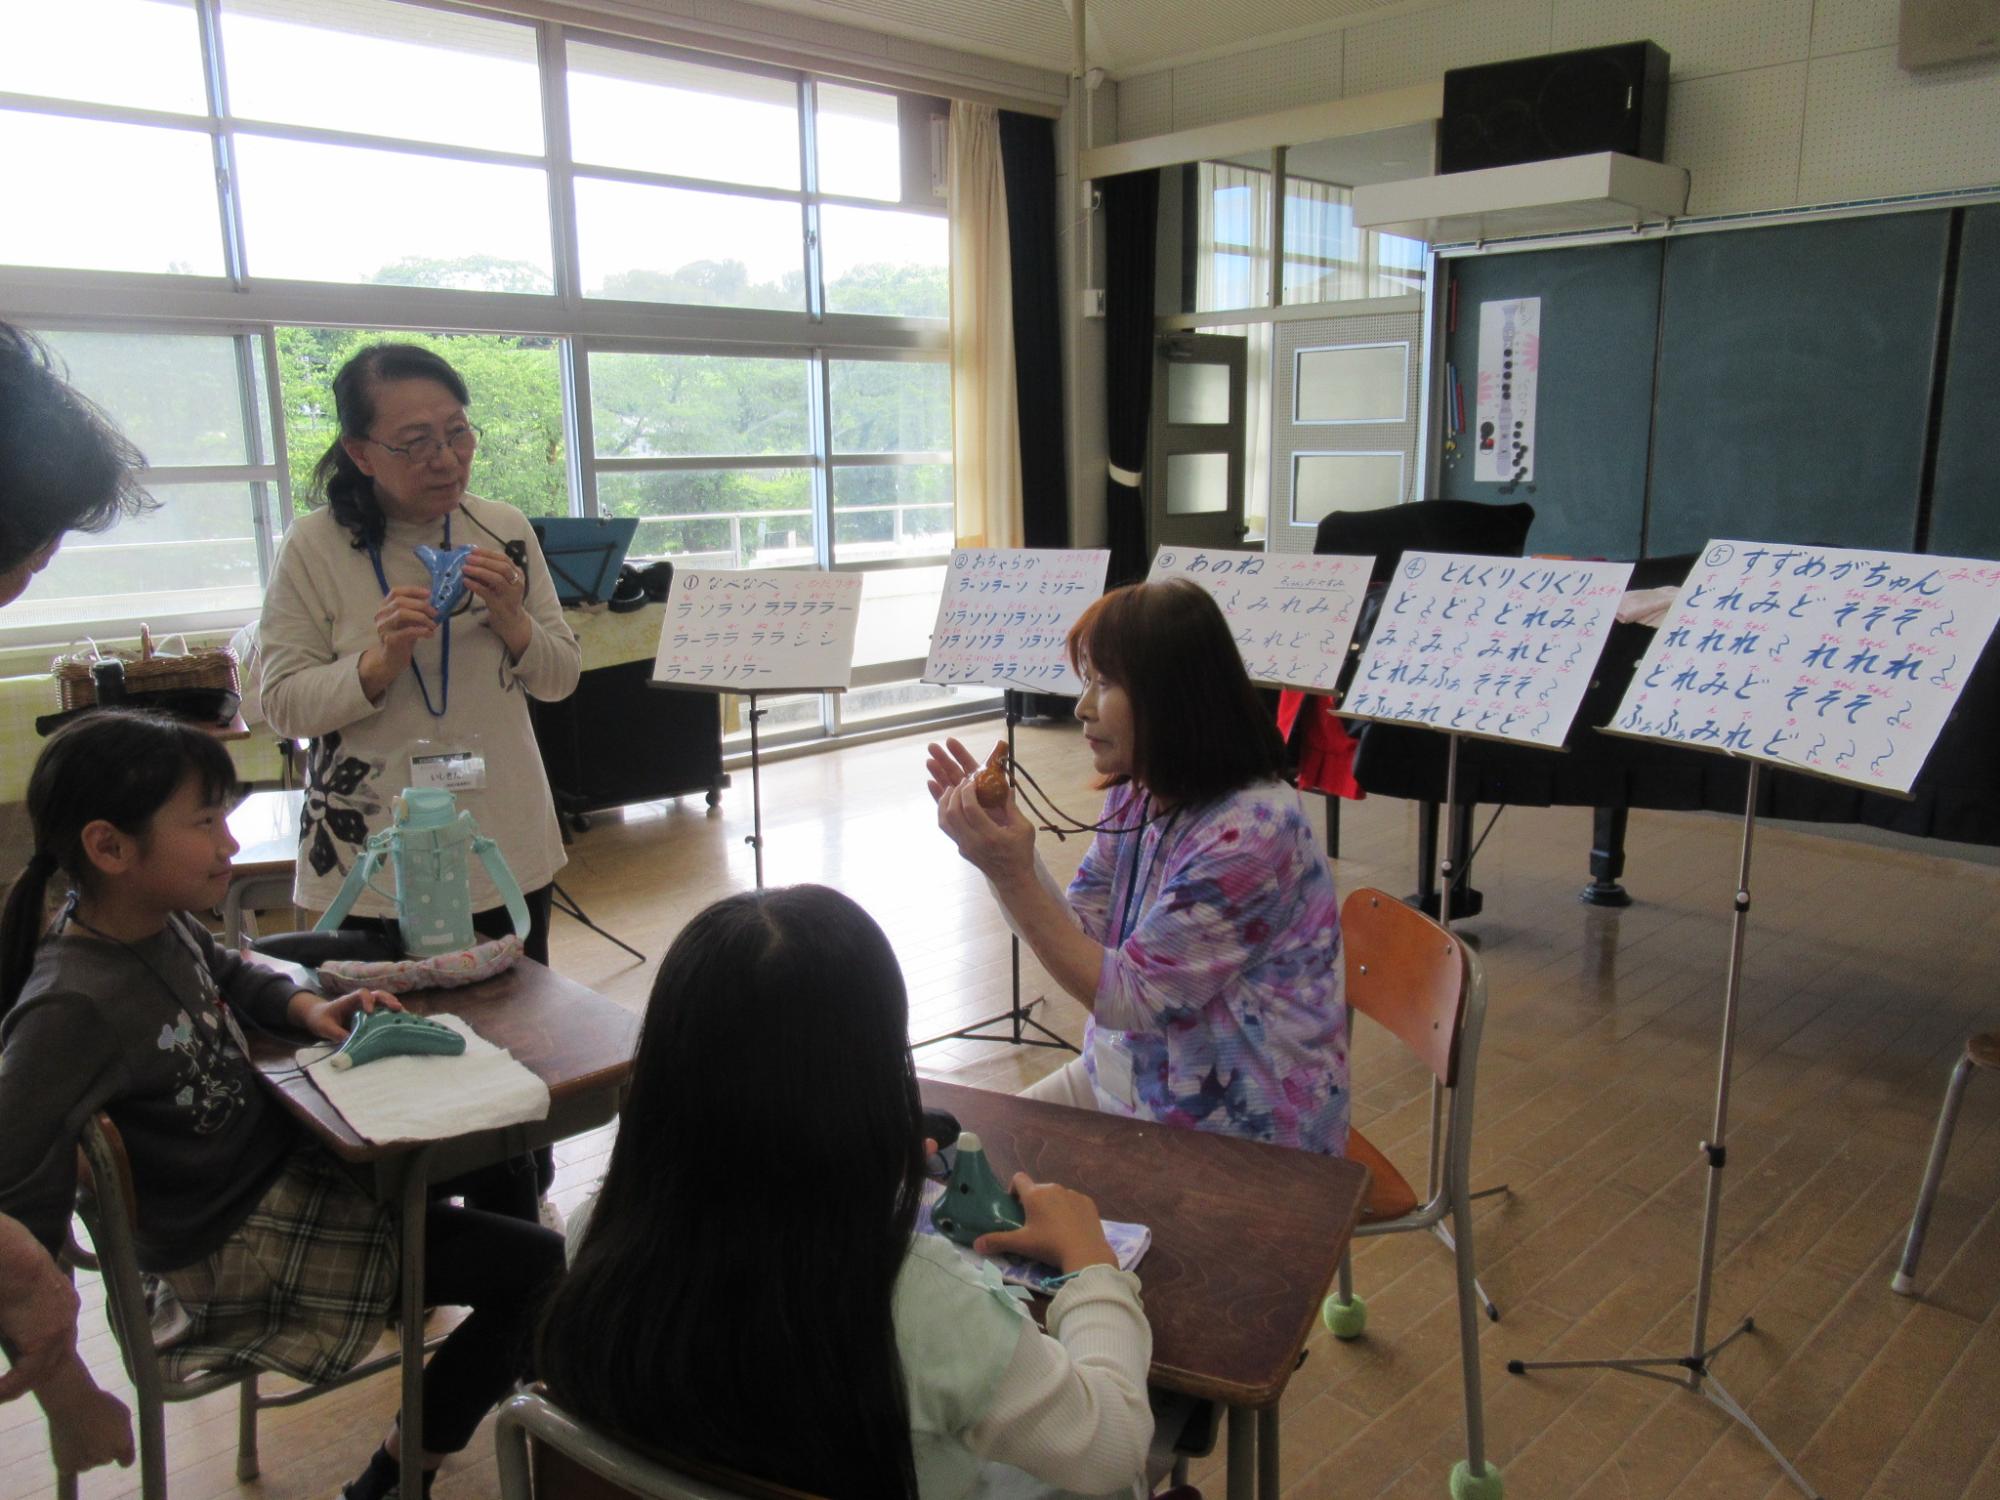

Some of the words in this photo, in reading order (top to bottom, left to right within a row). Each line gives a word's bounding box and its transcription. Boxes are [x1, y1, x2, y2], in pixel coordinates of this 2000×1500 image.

[972, 553, 1041, 571] おちゃらか
[1185, 553, 1265, 575] あのね
[1742, 550, 1945, 596] すずめがちゃん
[708, 576, 779, 591] なべなべ
[1440, 560, 1593, 597] どんぐりぐりぐり
